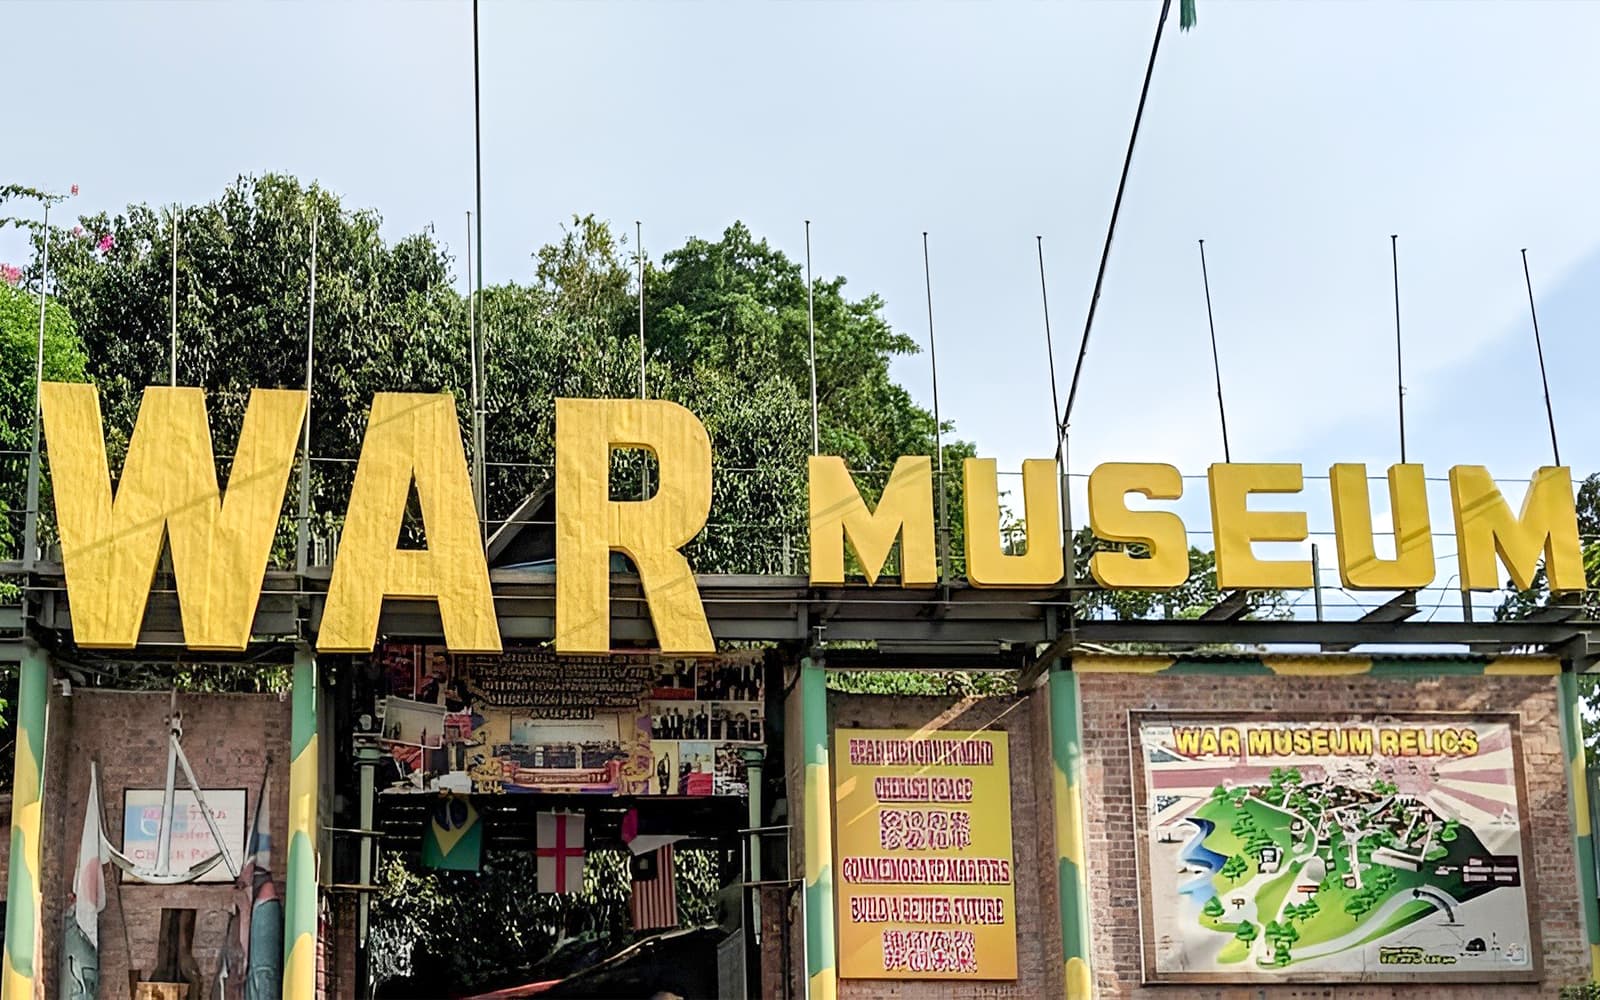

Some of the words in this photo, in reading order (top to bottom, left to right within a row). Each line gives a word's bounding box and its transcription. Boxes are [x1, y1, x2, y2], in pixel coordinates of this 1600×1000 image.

[40, 382, 716, 655] WAR
[807, 454, 1588, 594] MUSEUM
[1172, 726, 1241, 757] WAR
[1247, 727, 1373, 757] MUSEUM
[1379, 727, 1480, 757] RELICS
